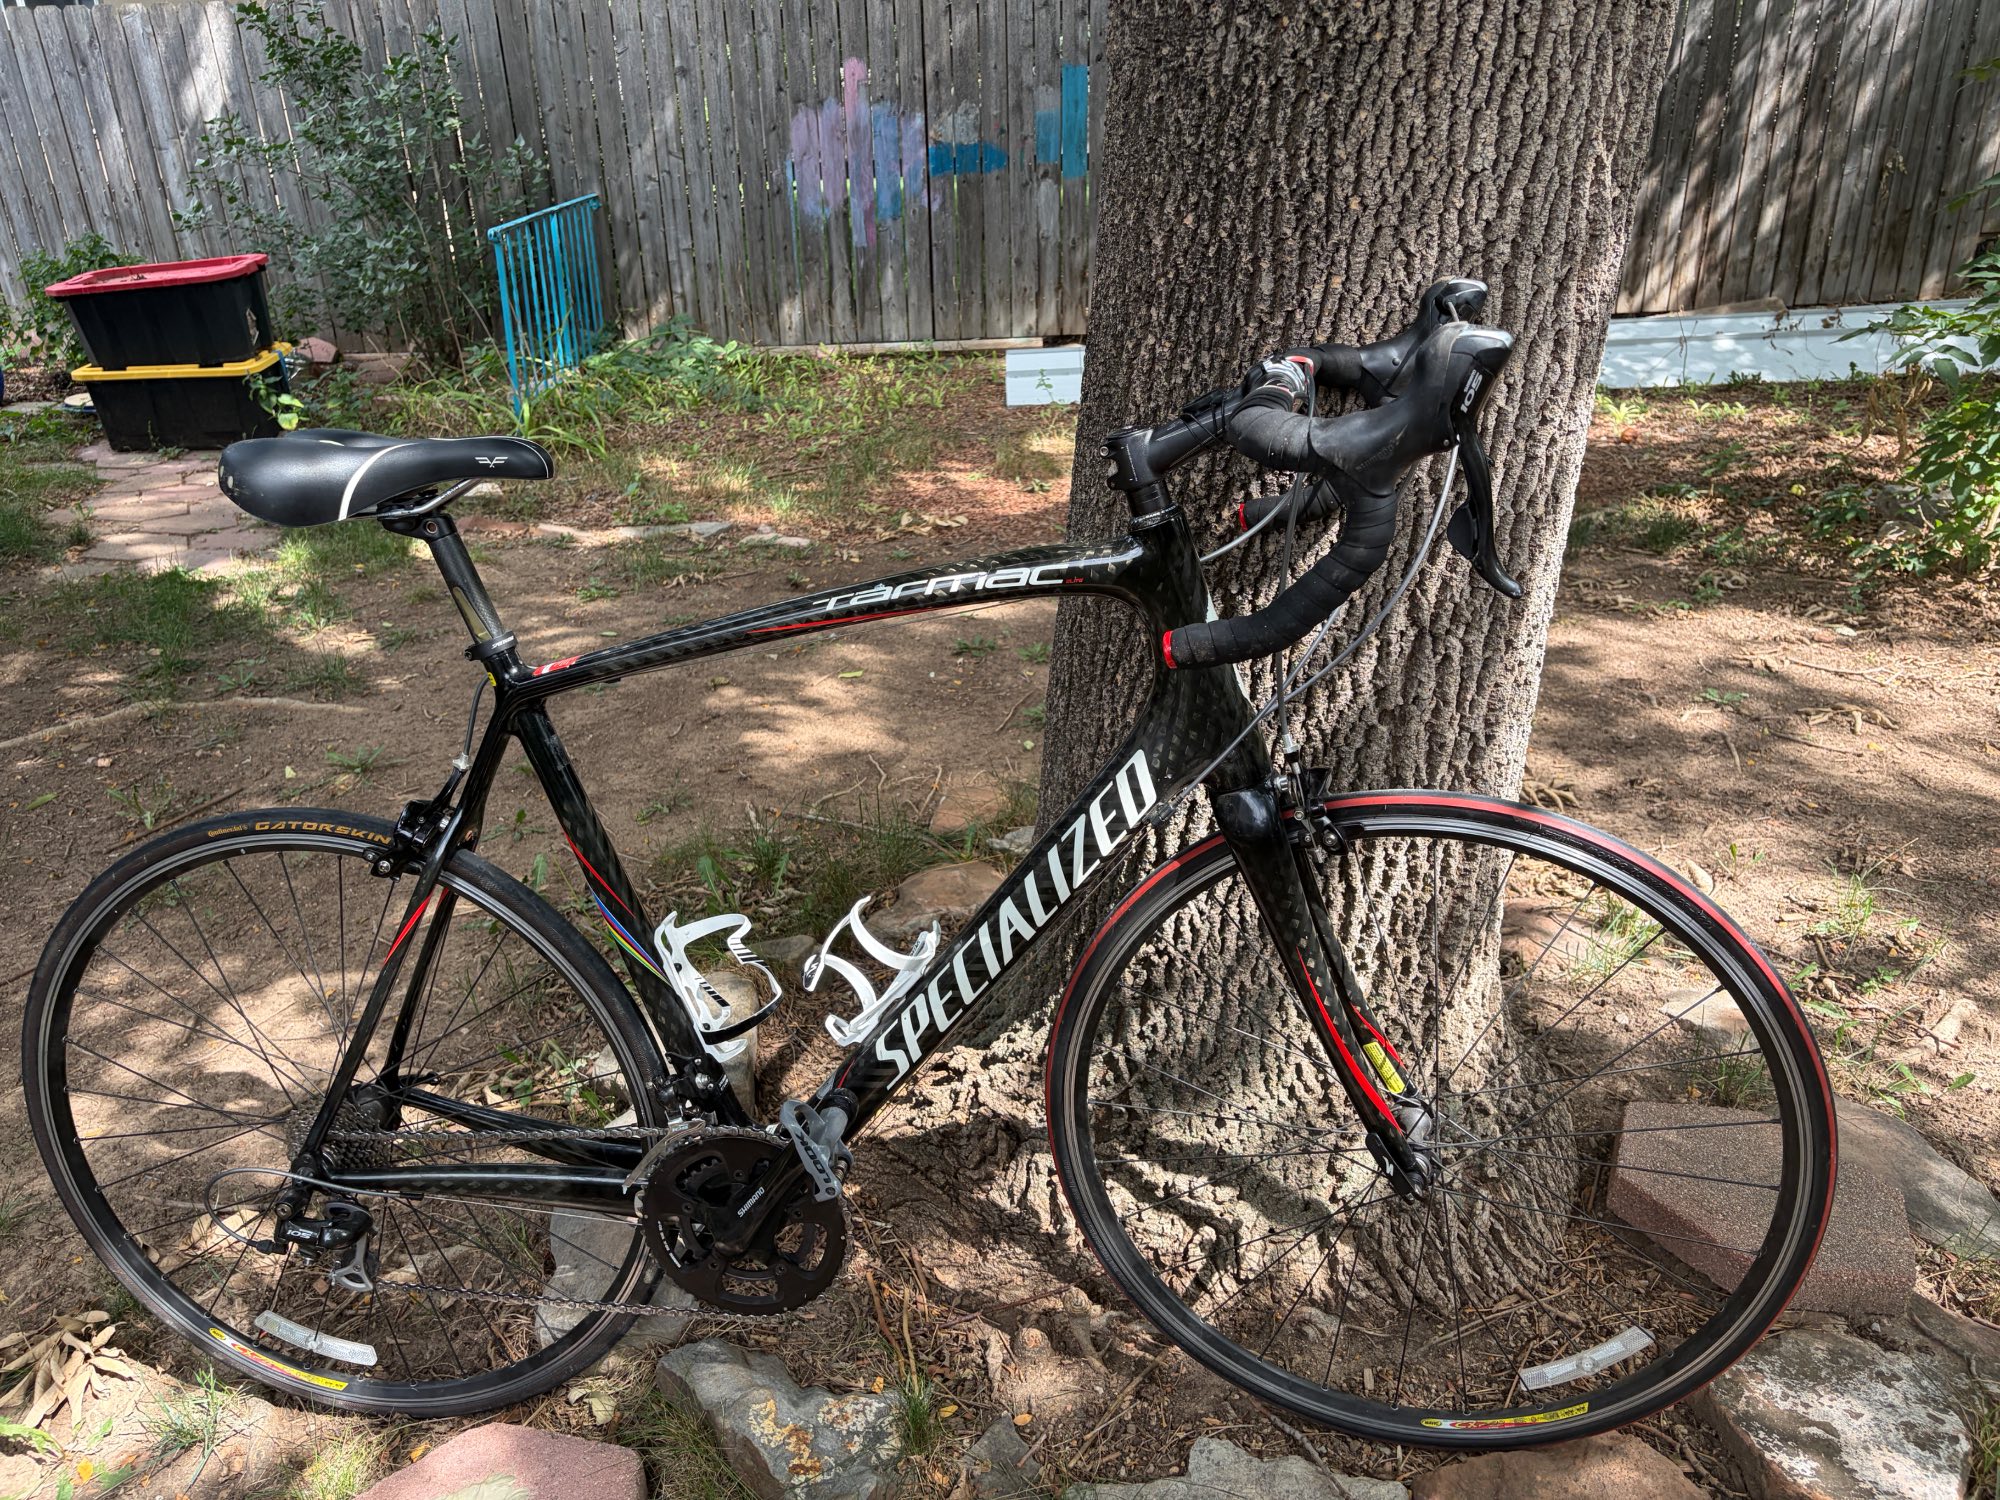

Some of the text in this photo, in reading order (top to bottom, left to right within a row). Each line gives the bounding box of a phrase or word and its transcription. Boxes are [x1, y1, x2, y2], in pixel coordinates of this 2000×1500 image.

[1460, 371, 1483, 414] 105
[255, 820, 392, 845] GATORSKIN
[875, 749, 1157, 1091] SPECIALIZED
[795, 1132, 832, 1184] LOOK
[737, 1186, 765, 1218] SHIMANO
[286, 1228, 314, 1240] 105
